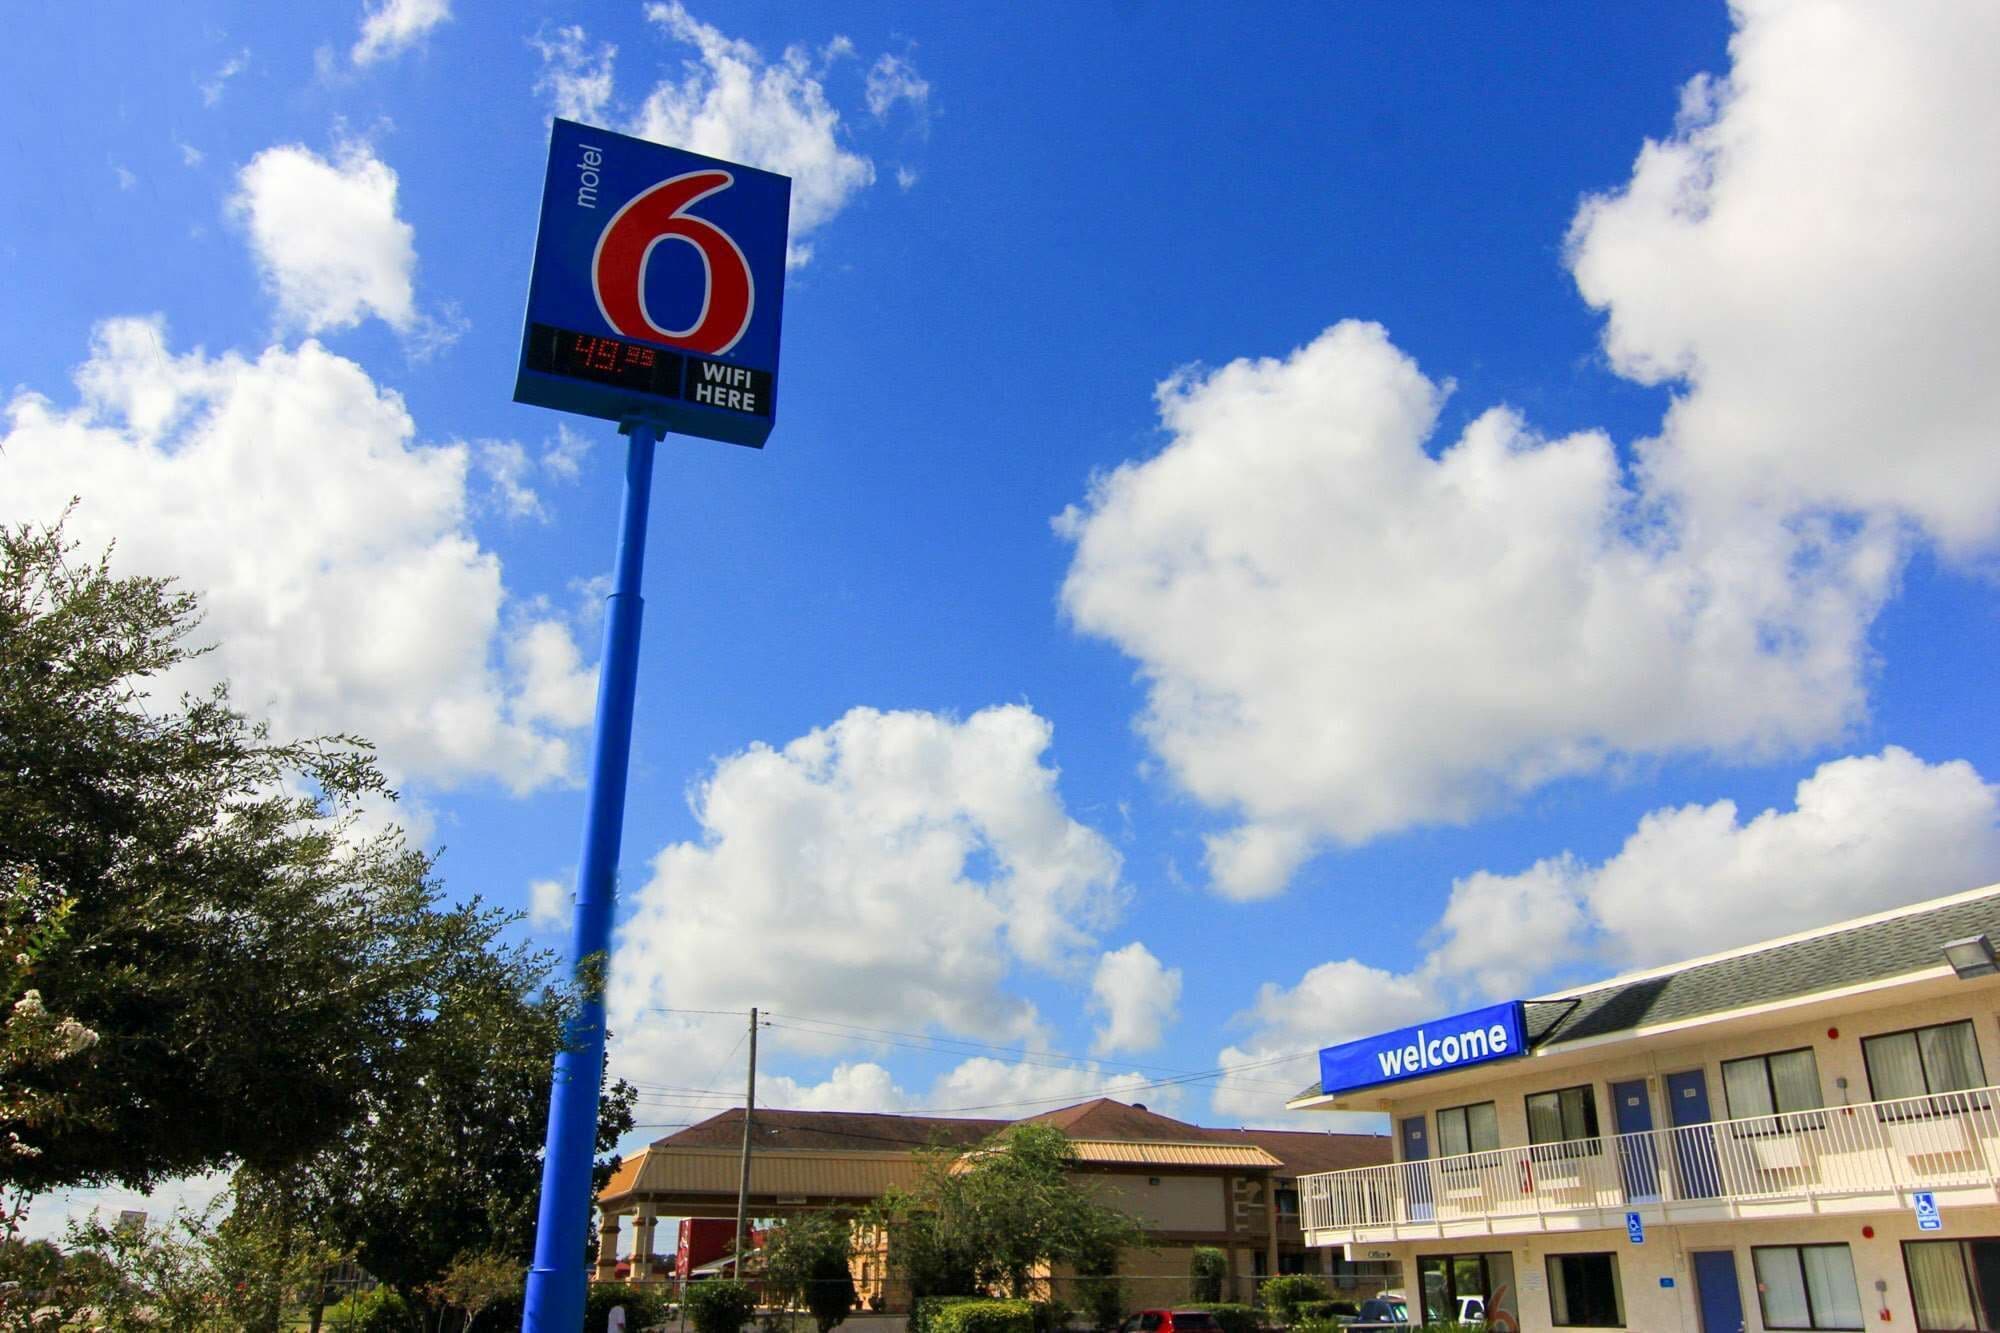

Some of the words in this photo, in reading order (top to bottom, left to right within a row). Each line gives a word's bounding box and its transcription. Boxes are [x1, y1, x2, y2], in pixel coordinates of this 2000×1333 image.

[577, 143, 603, 209] motel
[591, 169, 755, 356] 6
[696, 383, 755, 412] HERE
[703, 361, 751, 389] WIFI
[1378, 1024, 1508, 1077] welcome
